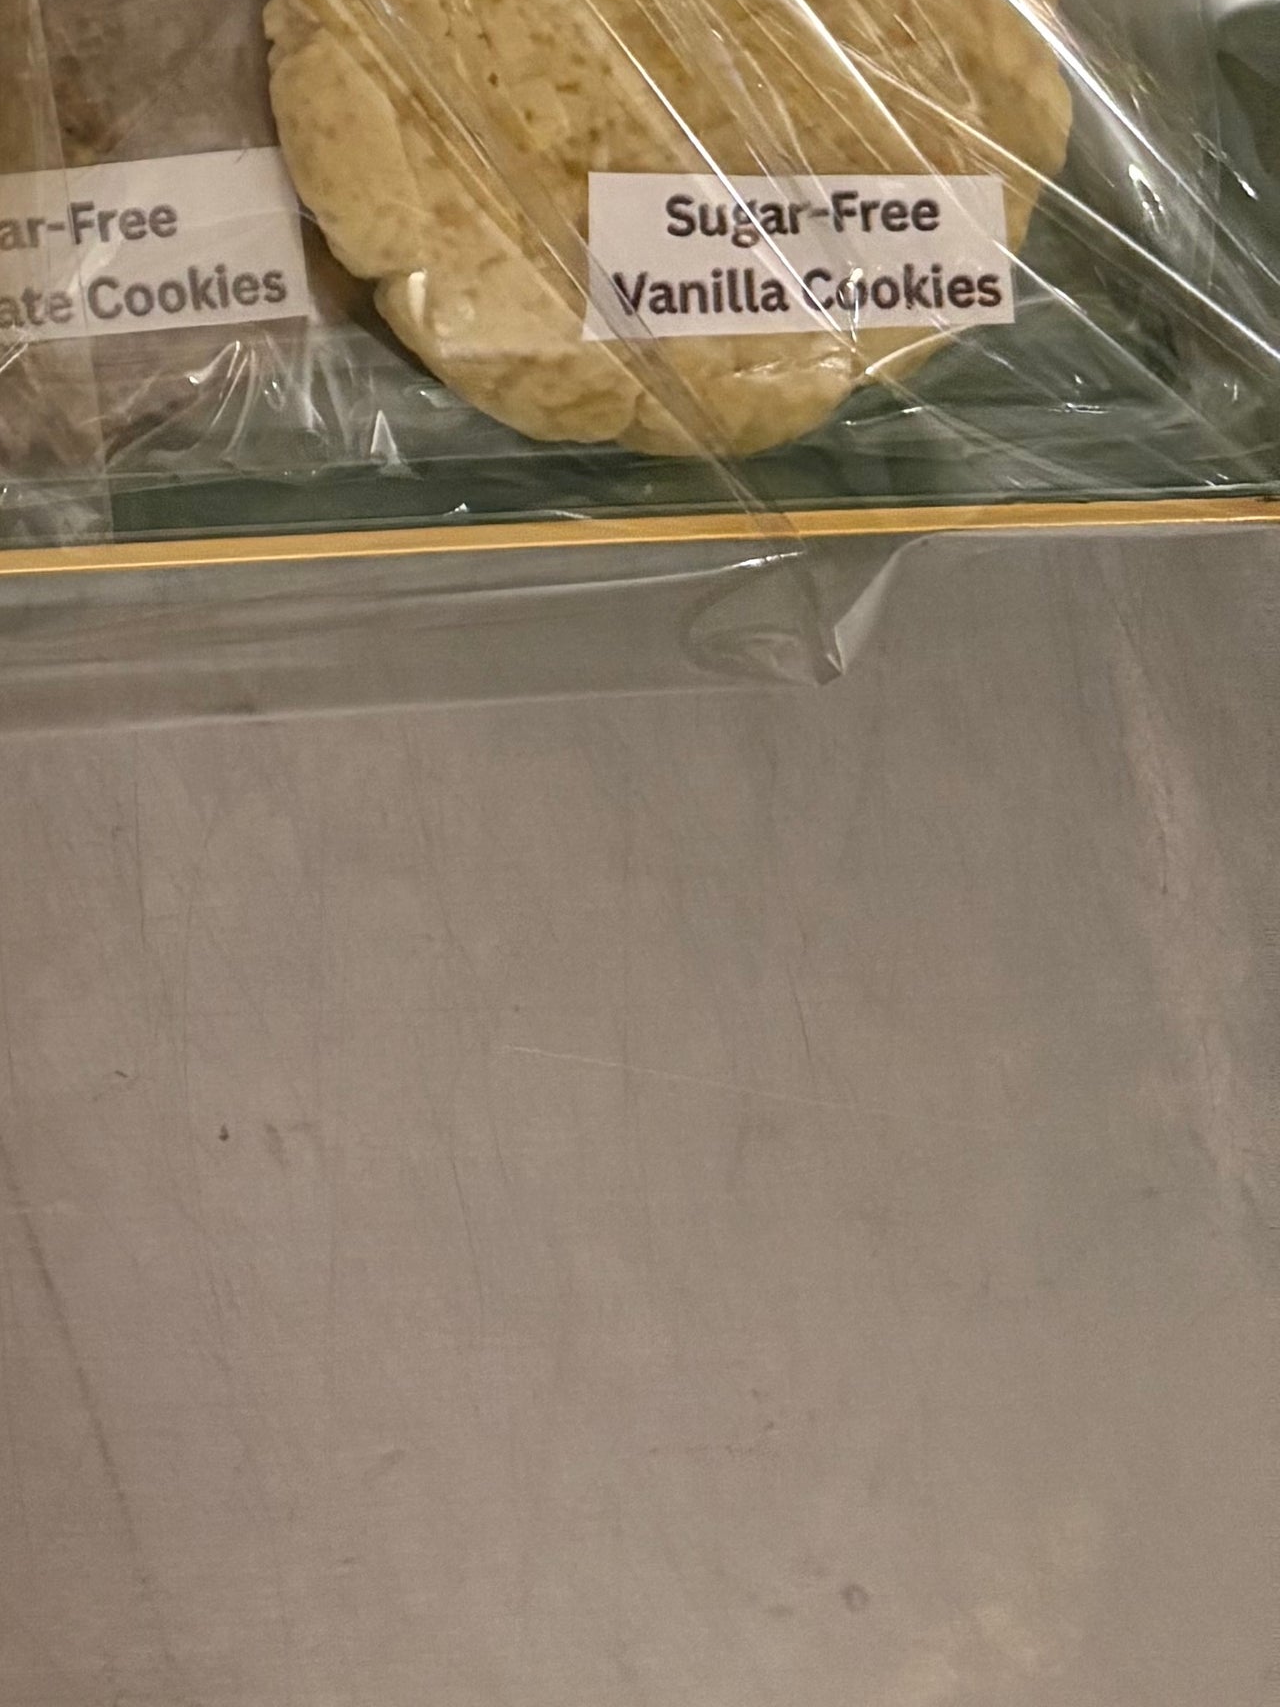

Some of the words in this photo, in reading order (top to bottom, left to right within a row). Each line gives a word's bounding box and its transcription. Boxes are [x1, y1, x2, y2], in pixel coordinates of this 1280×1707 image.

[665, 191, 940, 248] Sugar-Free
[87, 264, 288, 320] Cookies
[612, 268, 791, 316] Vanilla
[802, 263, 1003, 311] Cookies
